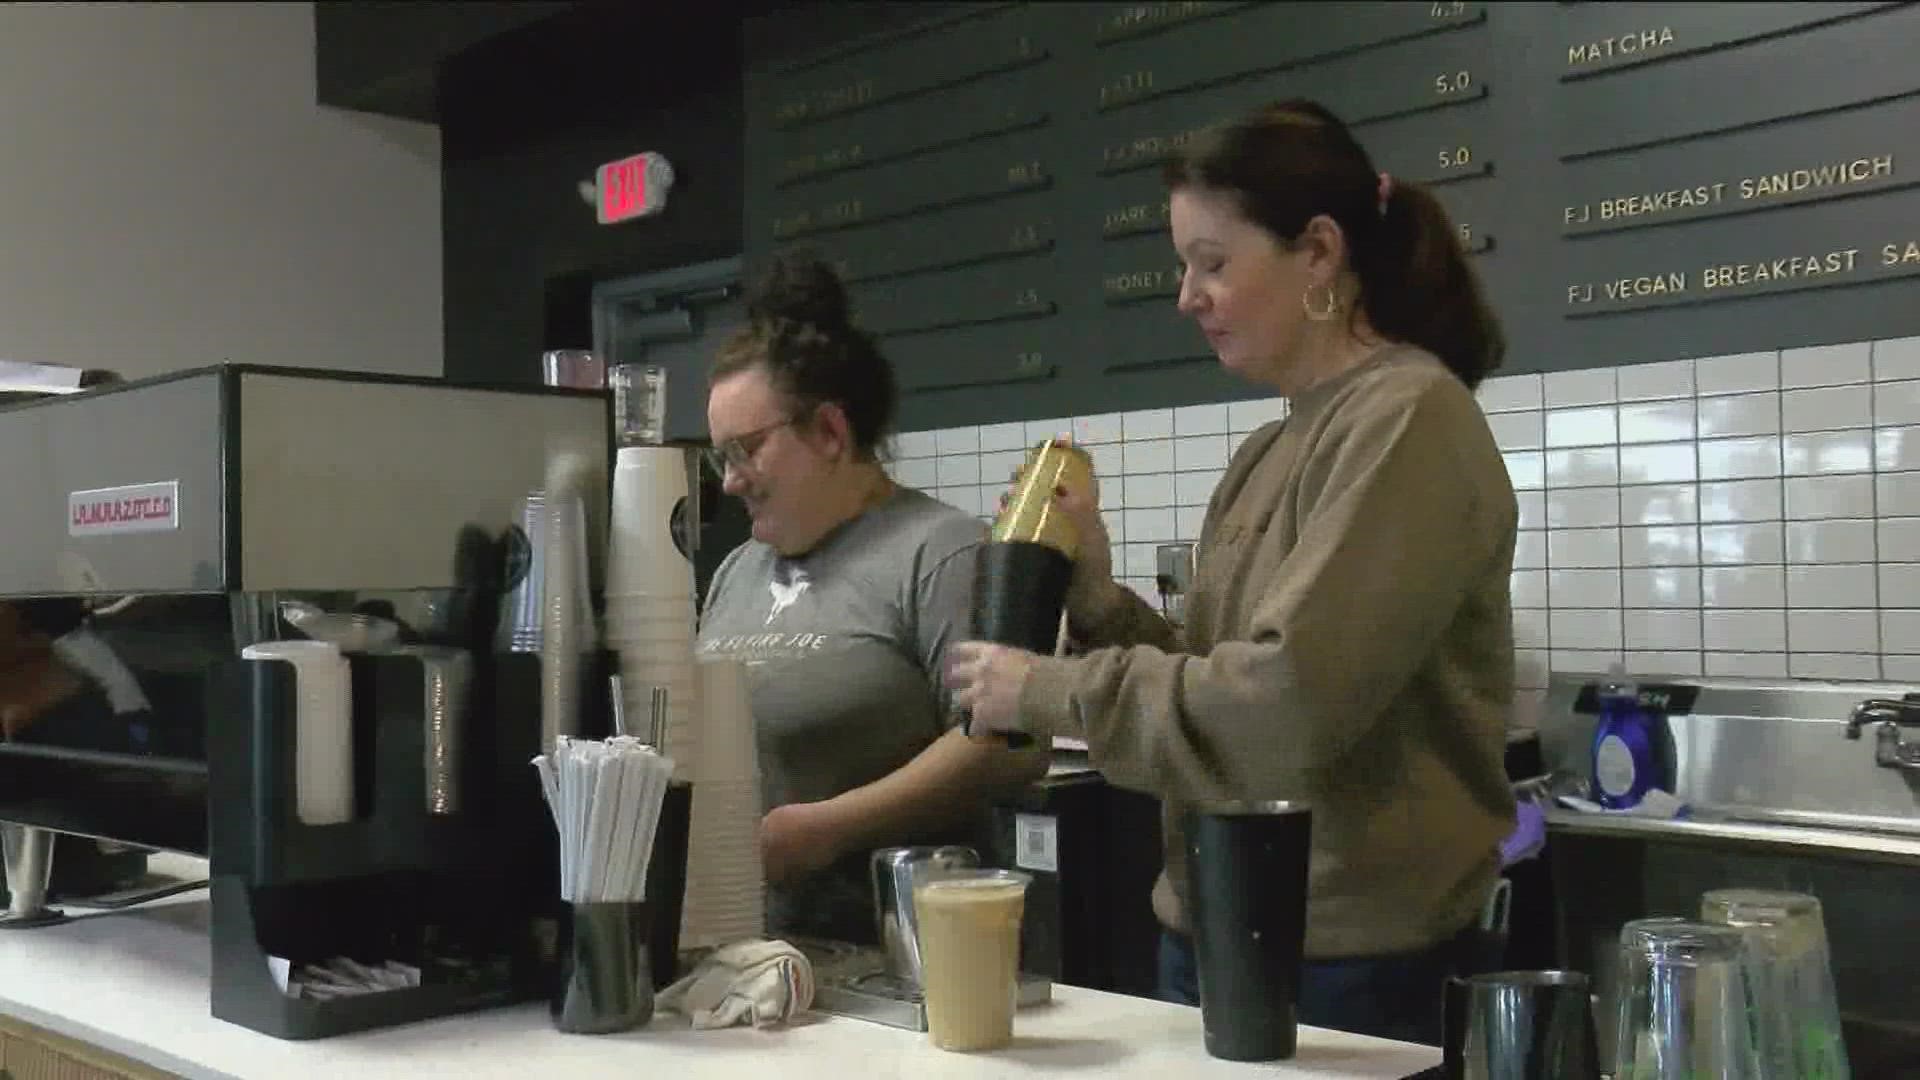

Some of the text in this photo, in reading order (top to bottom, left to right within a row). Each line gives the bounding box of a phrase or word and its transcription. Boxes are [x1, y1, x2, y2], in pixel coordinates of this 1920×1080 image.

[1568, 26, 1674, 64] MATCHA
[1435, 71, 1470, 94] 5.0
[1438, 147, 1470, 168] 5.0
[1565, 154, 1894, 225] FJ BREAKFAST SANDWICH
[1567, 283, 1594, 304] FJ
[1604, 272, 1686, 300] VEGAN
[1703, 250, 1859, 289] BREAKFAST
[786, 632, 828, 650] JOE
